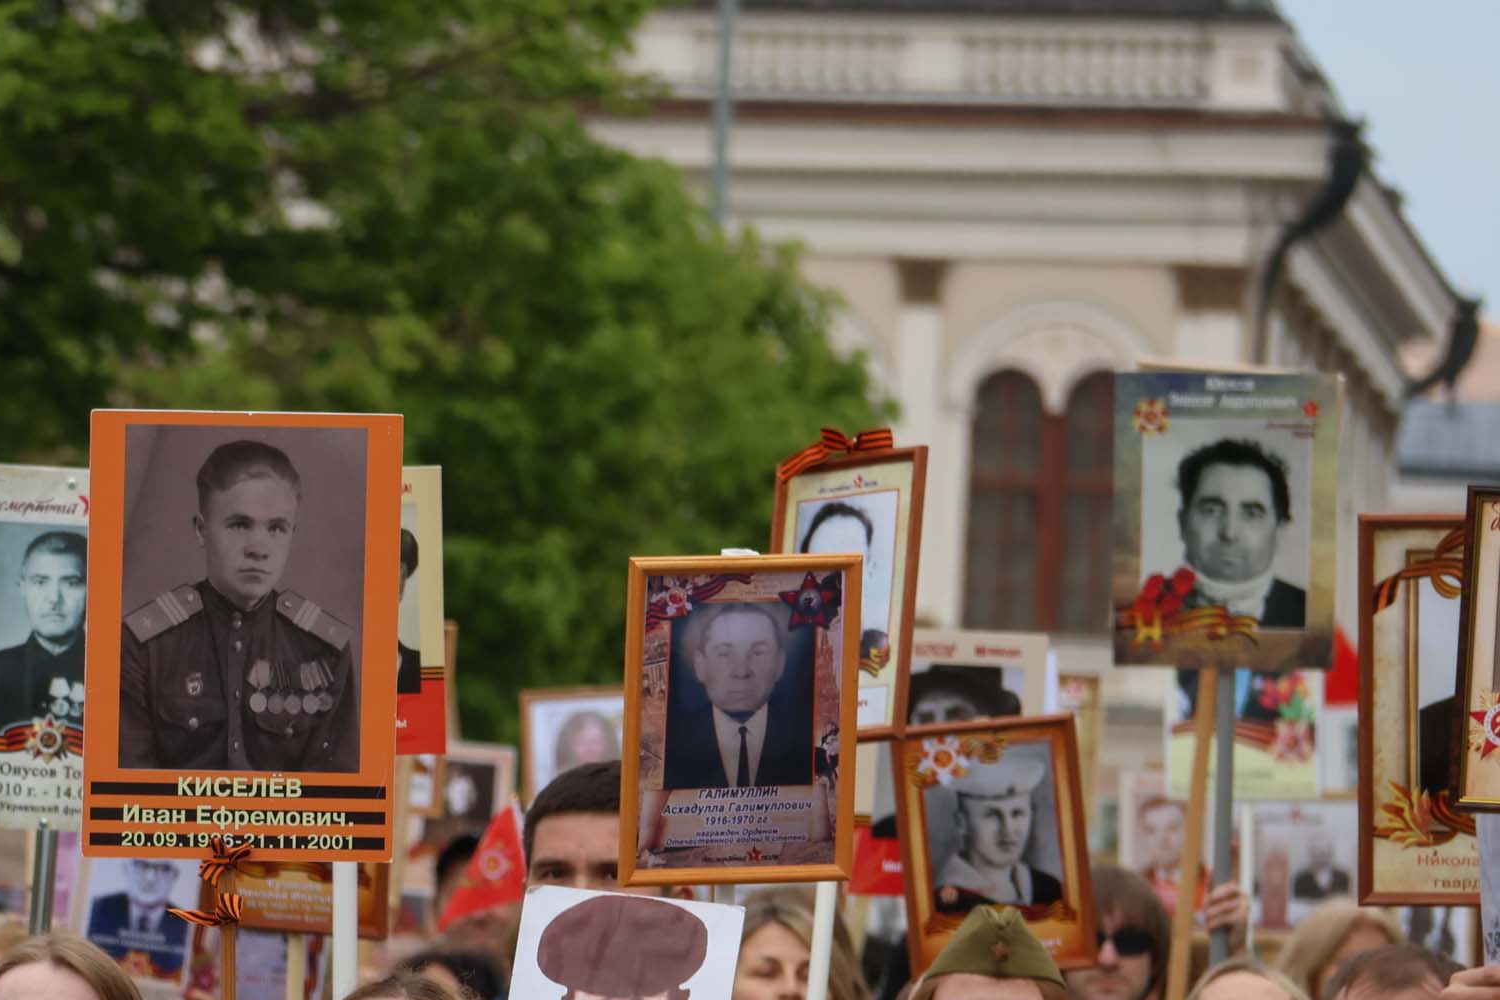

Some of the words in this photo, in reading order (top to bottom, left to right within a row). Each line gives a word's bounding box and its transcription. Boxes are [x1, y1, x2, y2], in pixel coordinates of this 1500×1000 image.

[177, 773, 303, 798] КИСЕЛЁВ
[699, 787, 779, 799] ГАЛИМУЛЛИН
[664, 802, 725, 816] Асхадулла
[729, 800, 812, 813] Галимуллович
[121, 803, 186, 824] Иван
[196, 804, 355, 830] Ефремович.
[705, 815, 754, 826] 1916-1970
